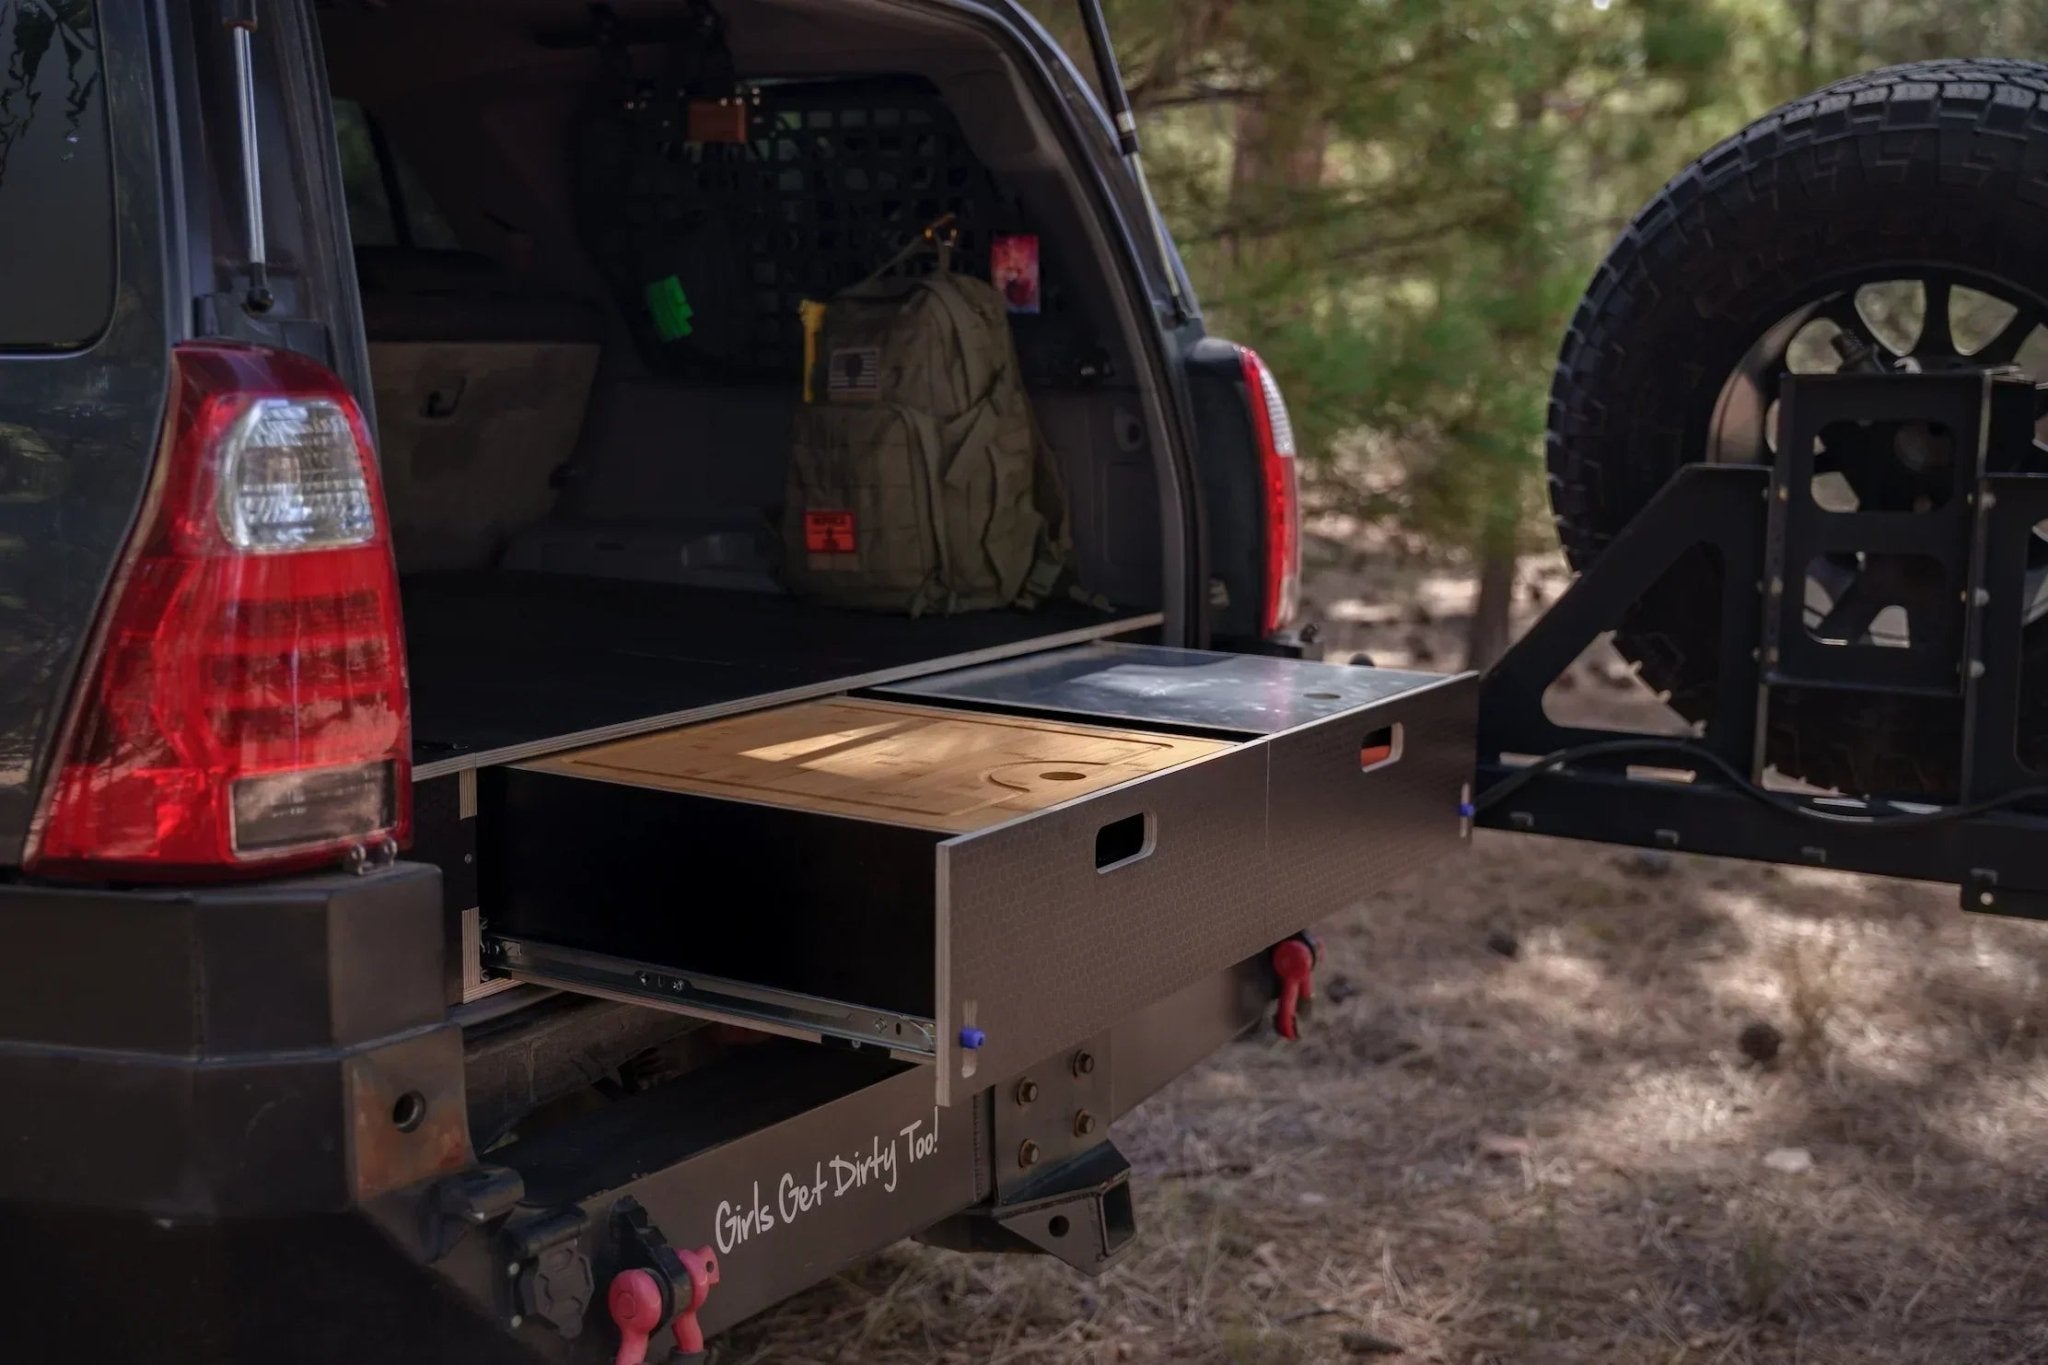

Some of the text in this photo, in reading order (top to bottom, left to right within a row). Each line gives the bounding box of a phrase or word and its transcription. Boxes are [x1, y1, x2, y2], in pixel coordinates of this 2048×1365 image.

[715, 1106, 940, 1254] Girls Get Dirty Too!
